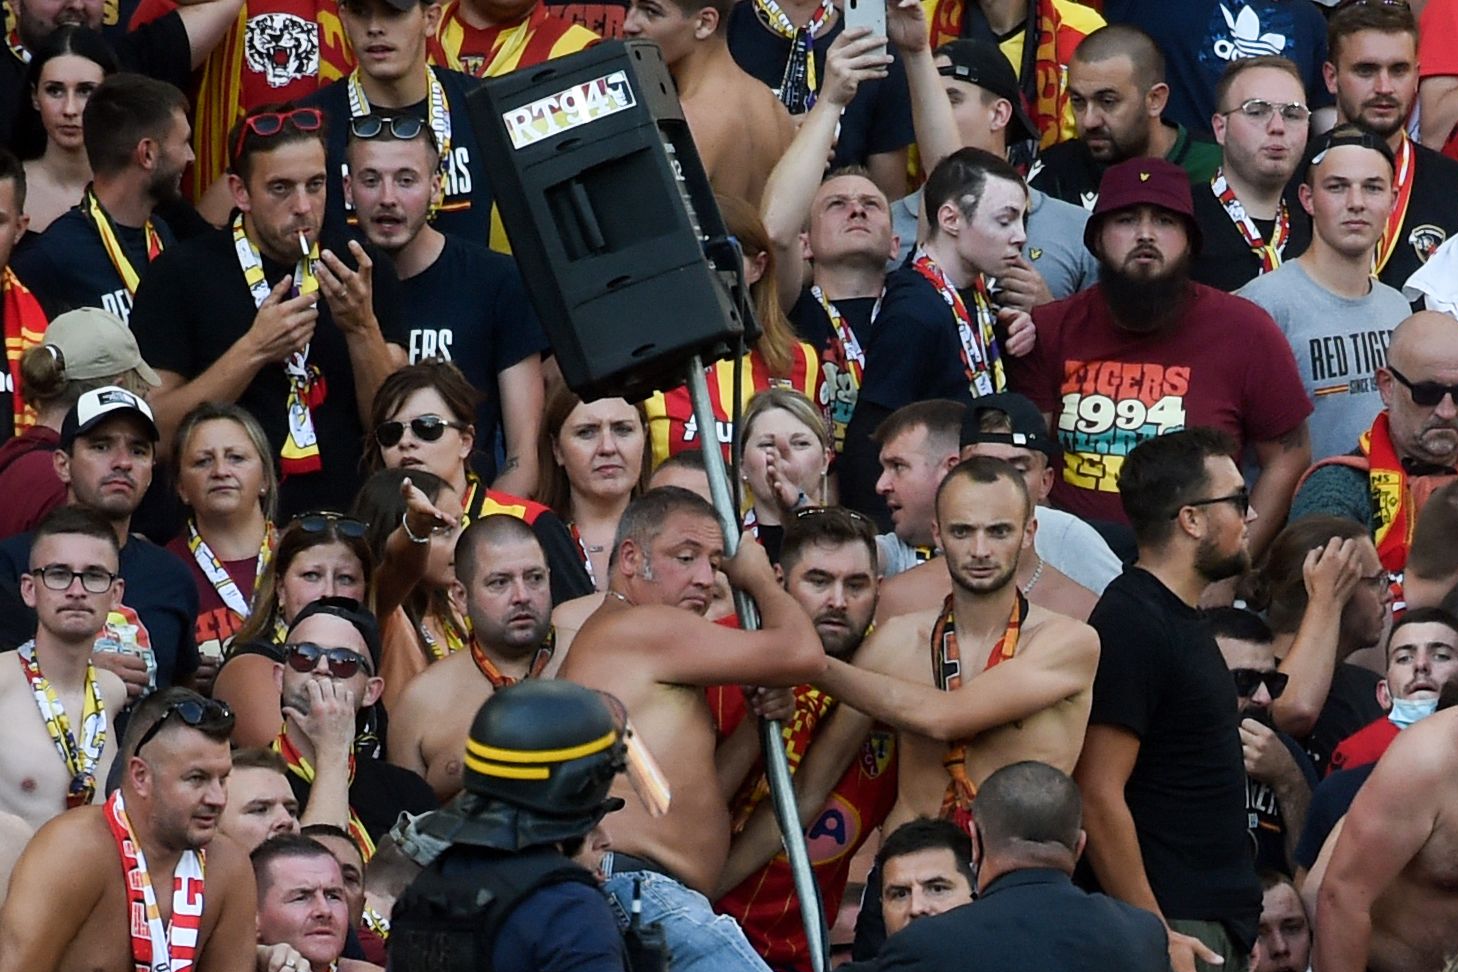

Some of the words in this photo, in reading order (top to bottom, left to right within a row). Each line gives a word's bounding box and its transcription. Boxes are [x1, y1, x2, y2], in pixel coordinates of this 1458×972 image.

[1309, 335, 1349, 381] RED
[1061, 360, 1191, 407] TIGERS
[1058, 393, 1186, 436] 1994
